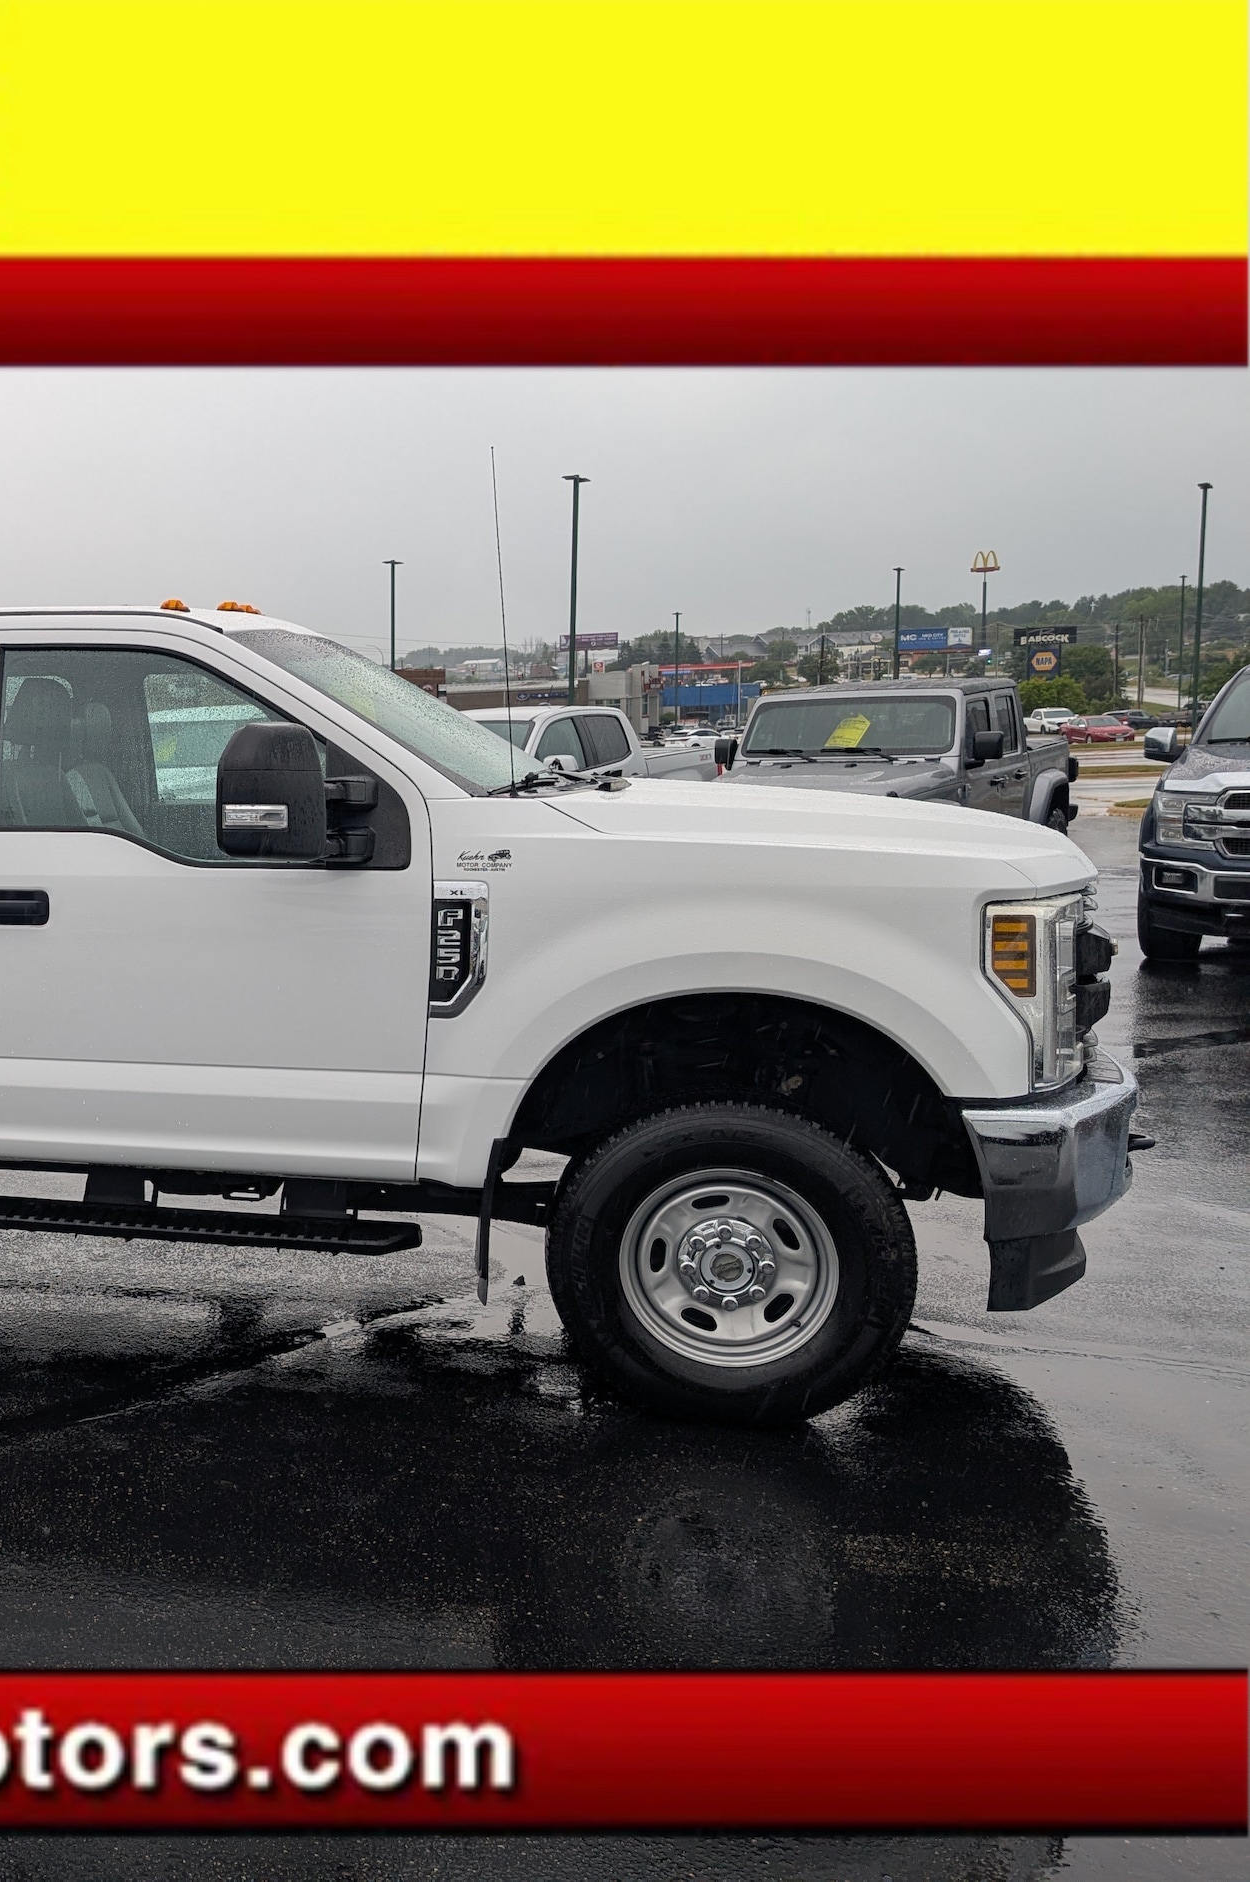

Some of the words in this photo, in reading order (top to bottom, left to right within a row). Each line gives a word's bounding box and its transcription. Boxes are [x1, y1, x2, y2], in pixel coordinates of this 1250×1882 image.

[1020, 634, 1069, 646] BABCOCK
[1035, 656, 1052, 666] NAPA
[456, 850, 485, 862] Kuehn
